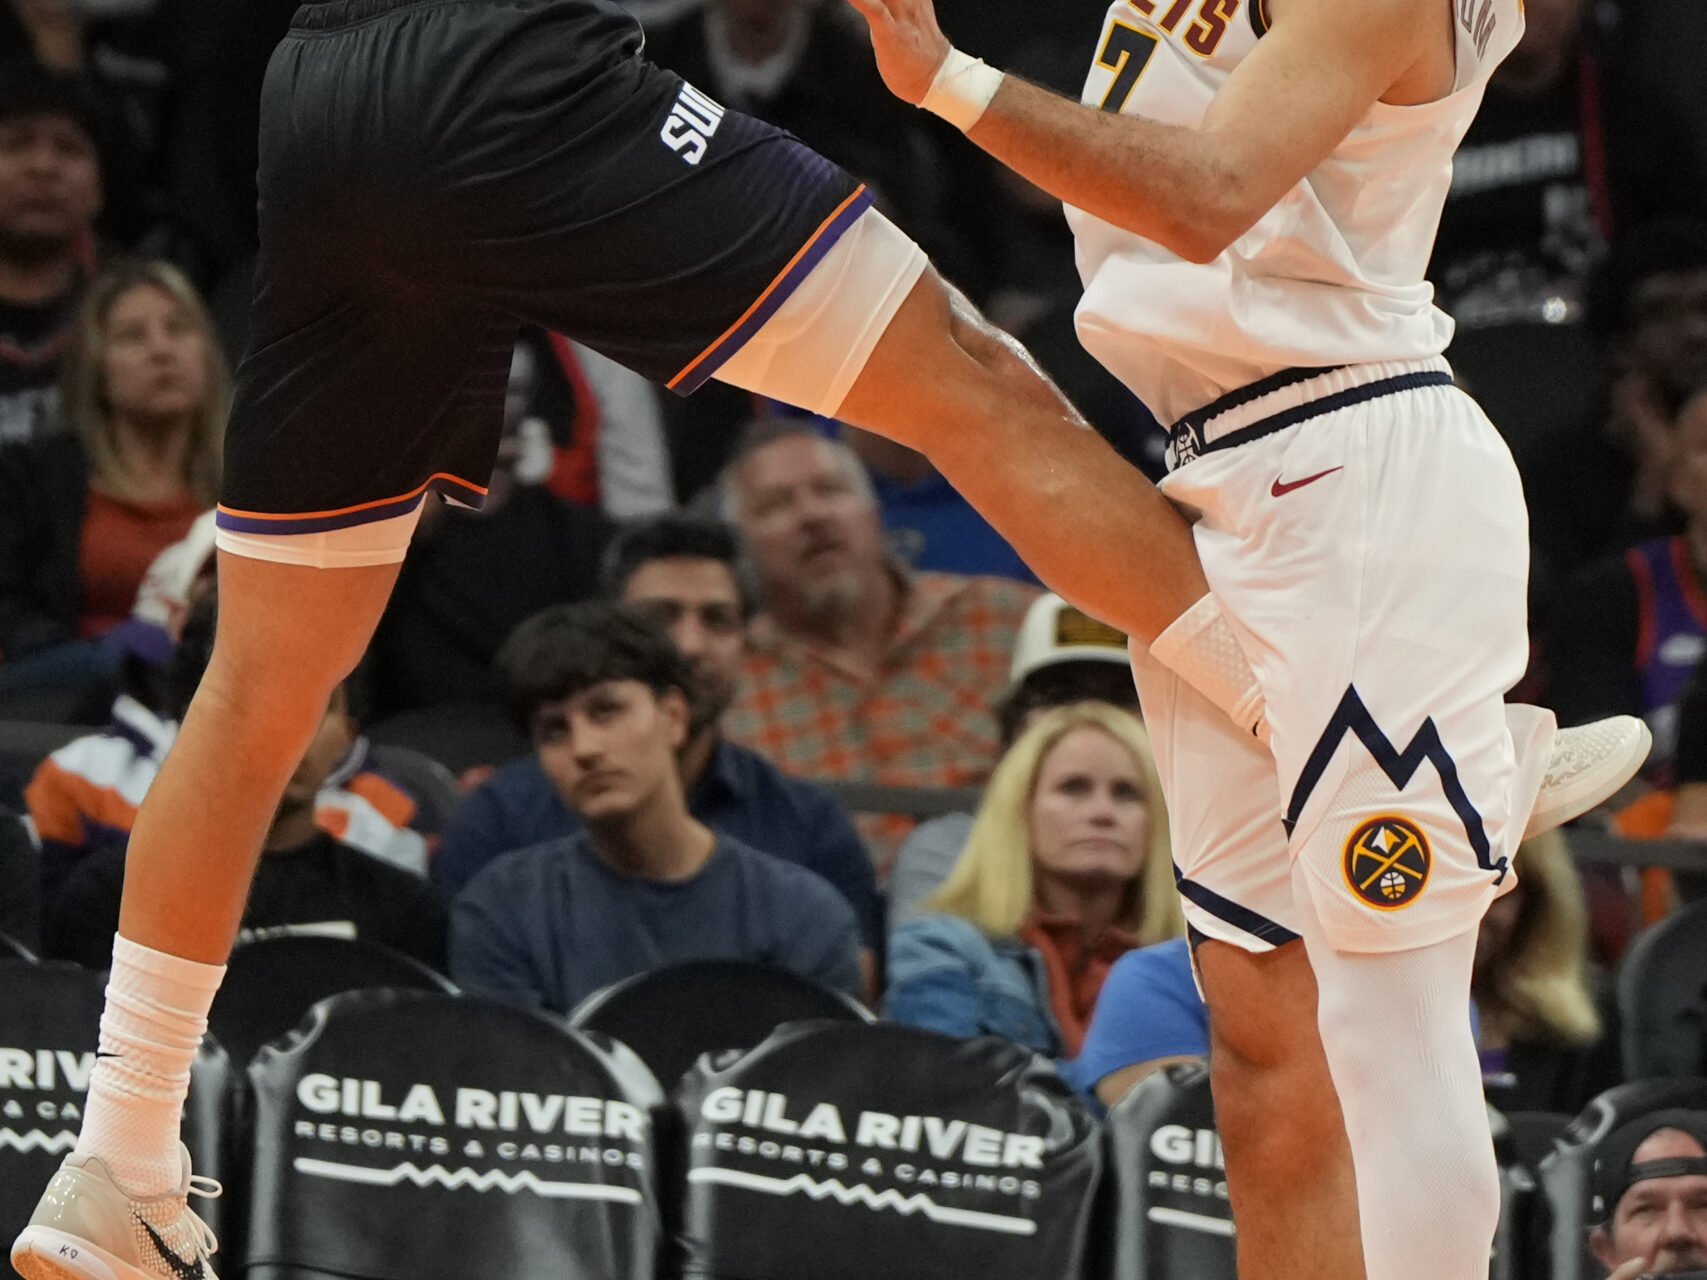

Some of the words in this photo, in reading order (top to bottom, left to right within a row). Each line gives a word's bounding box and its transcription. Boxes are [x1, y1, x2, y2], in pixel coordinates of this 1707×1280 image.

[1097, 19, 1161, 112] 7
[0, 1047, 95, 1091] RIV
[296, 1073, 446, 1126] GILA
[455, 1087, 644, 1143] RIVER
[701, 1086, 847, 1144] GILA
[855, 1110, 1044, 1170] RIVER
[295, 1120, 449, 1155] RESORTS
[463, 1140, 484, 1158] &
[497, 1141, 643, 1170] CASINOS
[692, 1132, 849, 1170] RESORTS
[894, 1163, 1042, 1199] CASINOS
[1149, 1171, 1229, 1199] RESO
